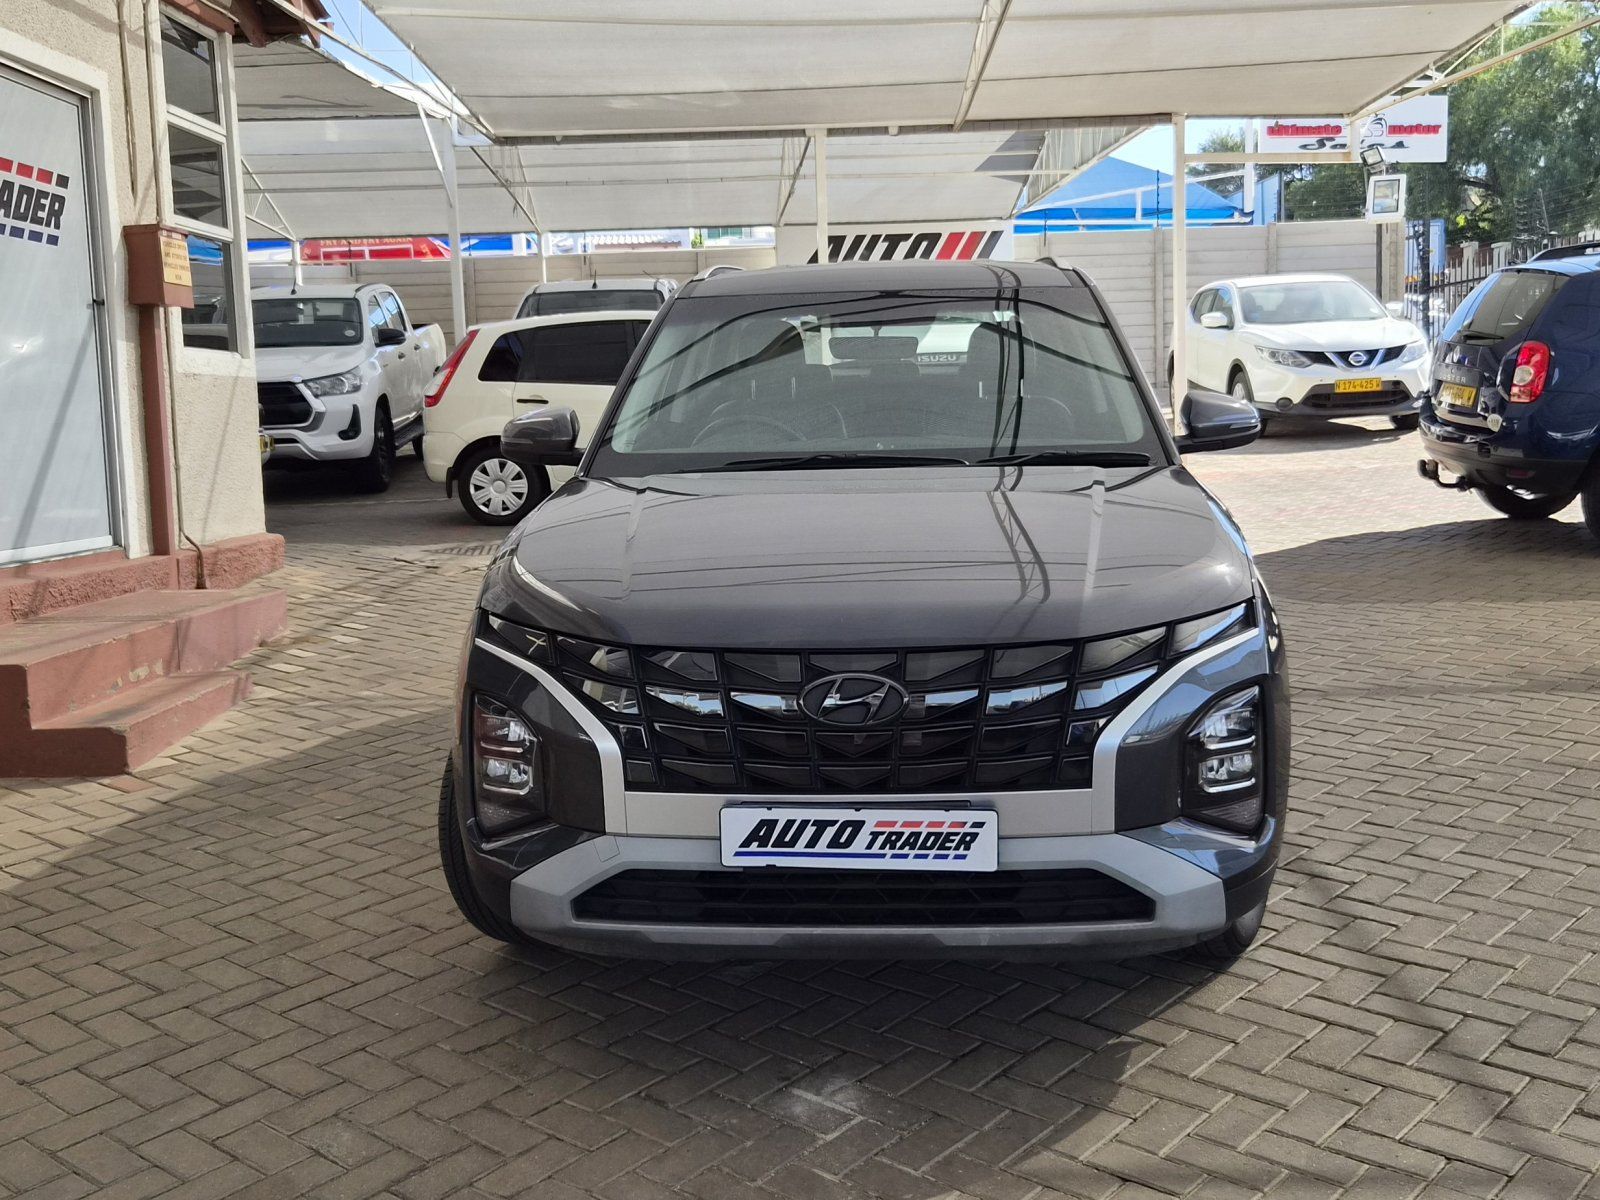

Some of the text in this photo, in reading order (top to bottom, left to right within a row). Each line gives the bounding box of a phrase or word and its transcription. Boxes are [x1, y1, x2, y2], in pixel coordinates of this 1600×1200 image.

[1388, 124, 1442, 135] motor
[917, 354, 957, 362] ISUZU
[738, 818, 980, 851] AUTO TRADER
